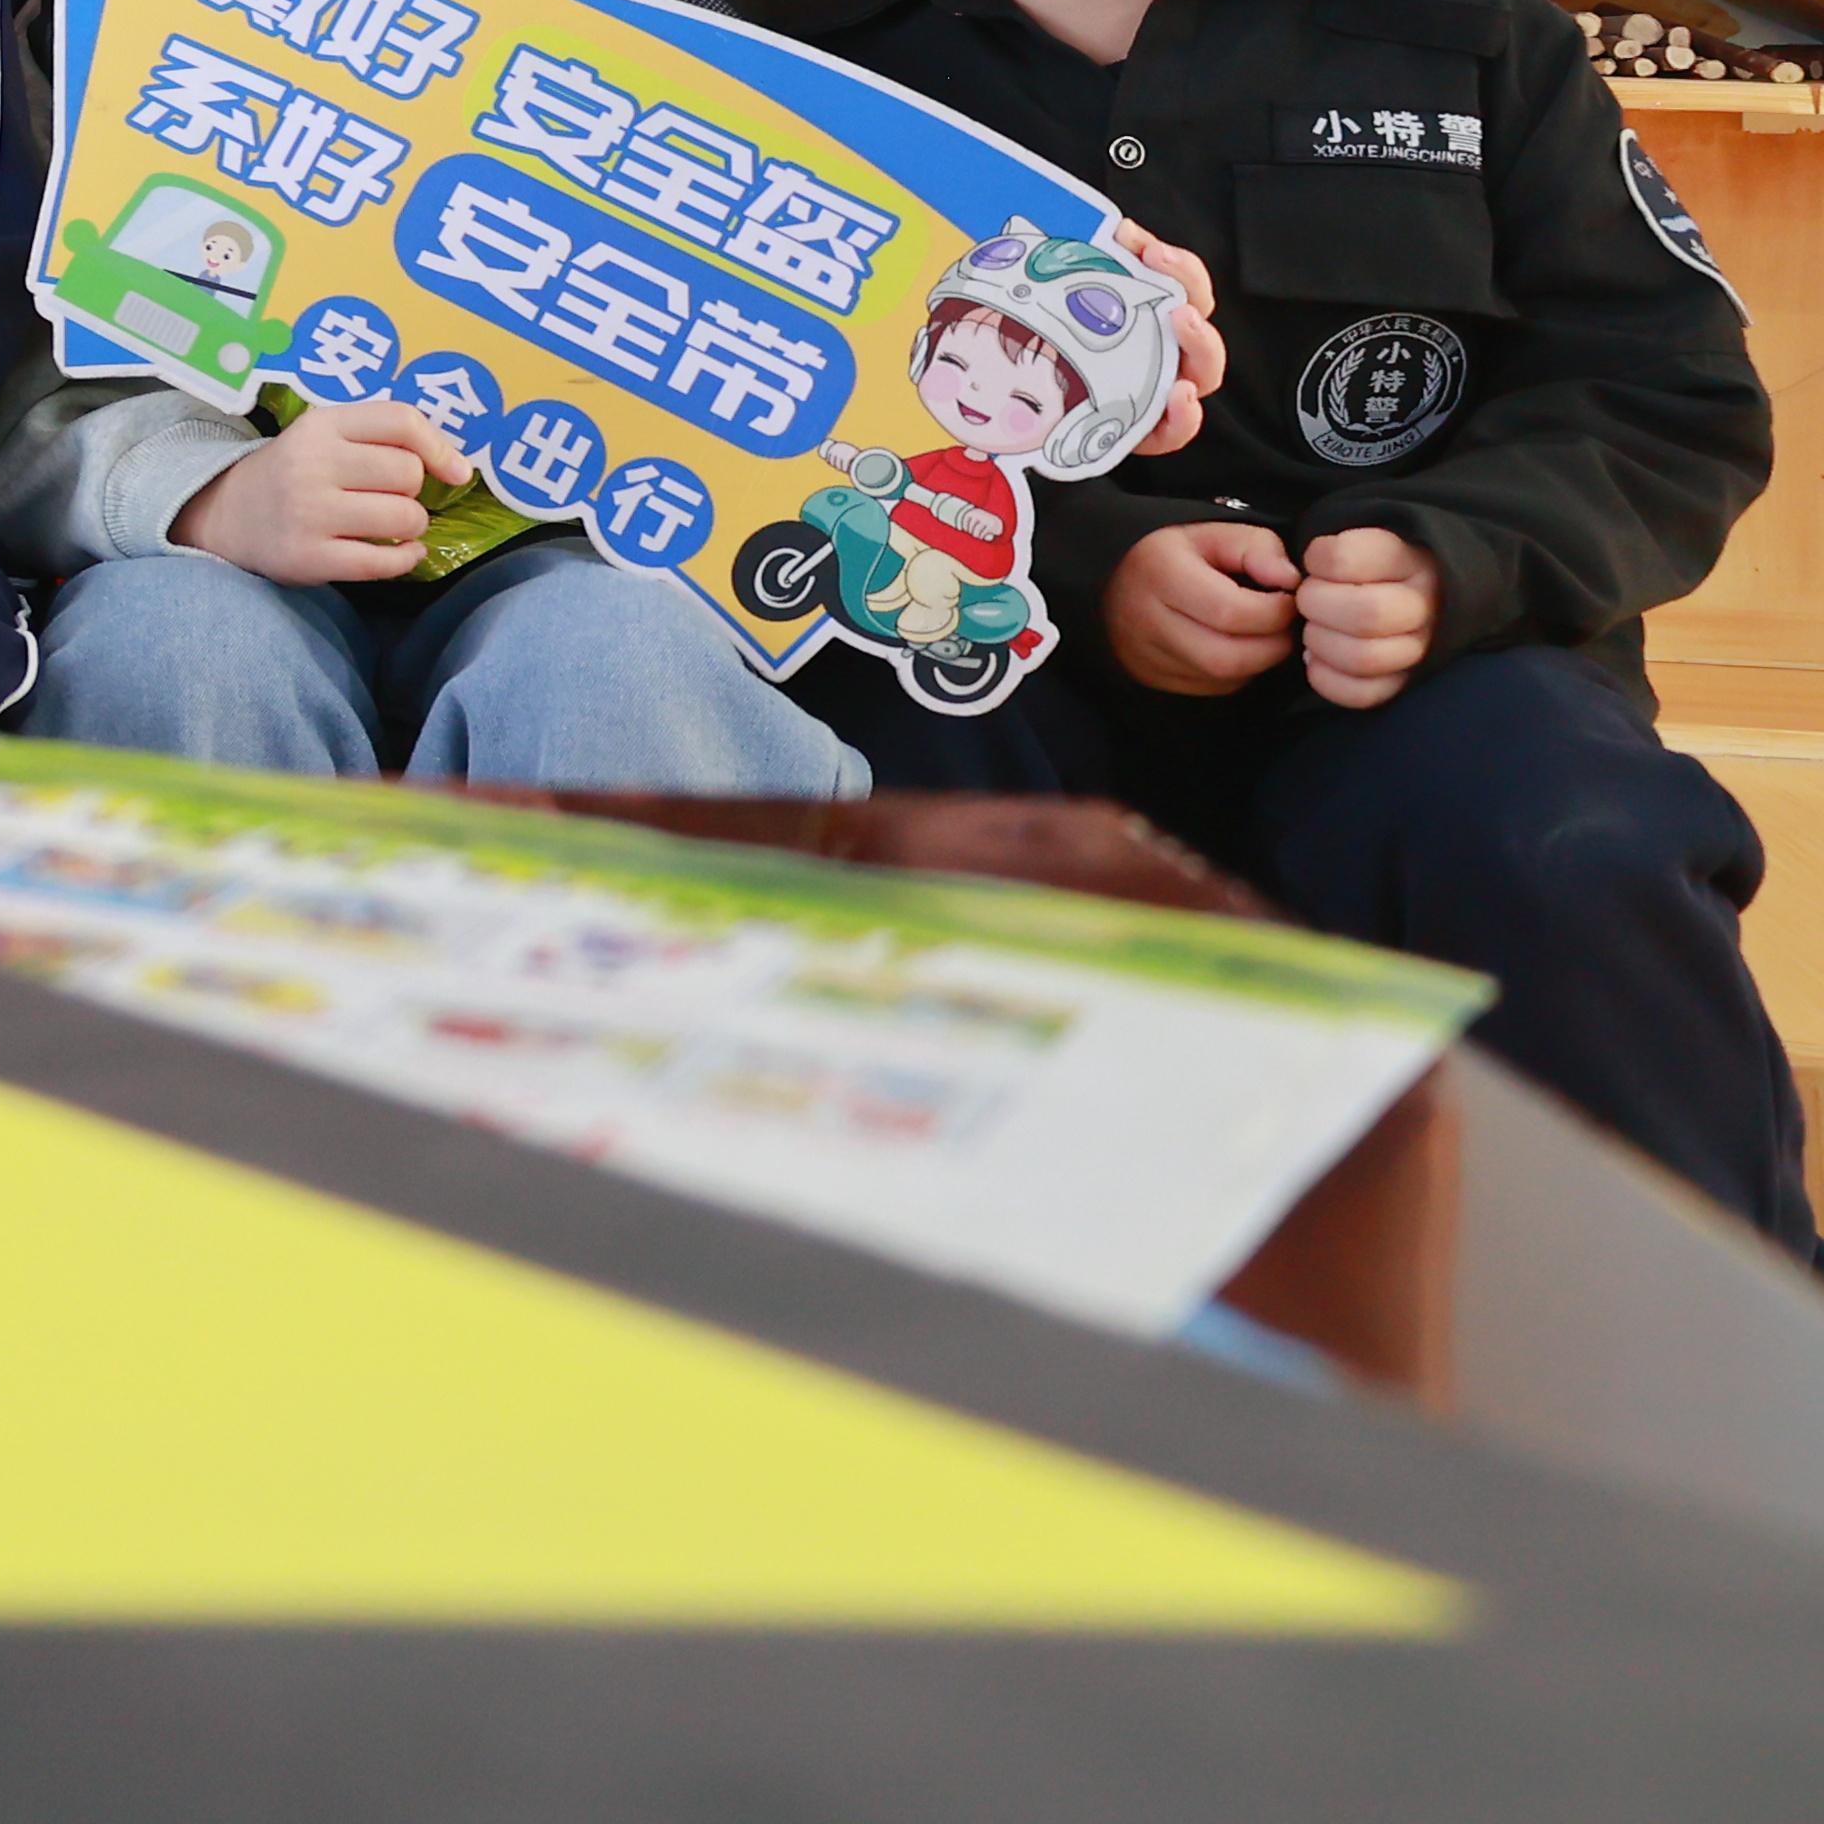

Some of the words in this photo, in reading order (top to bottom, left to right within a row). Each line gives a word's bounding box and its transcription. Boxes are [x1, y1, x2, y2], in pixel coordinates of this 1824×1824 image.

[128, 37, 407, 225] 系好
[414, 179, 833, 441] 安全带
[475, 44, 897, 313] 安全盔
[1311, 110, 1483, 155] 小特警
[308, 306, 706, 543] 安全出行
[1364, 341, 1412, 424] 小特警
